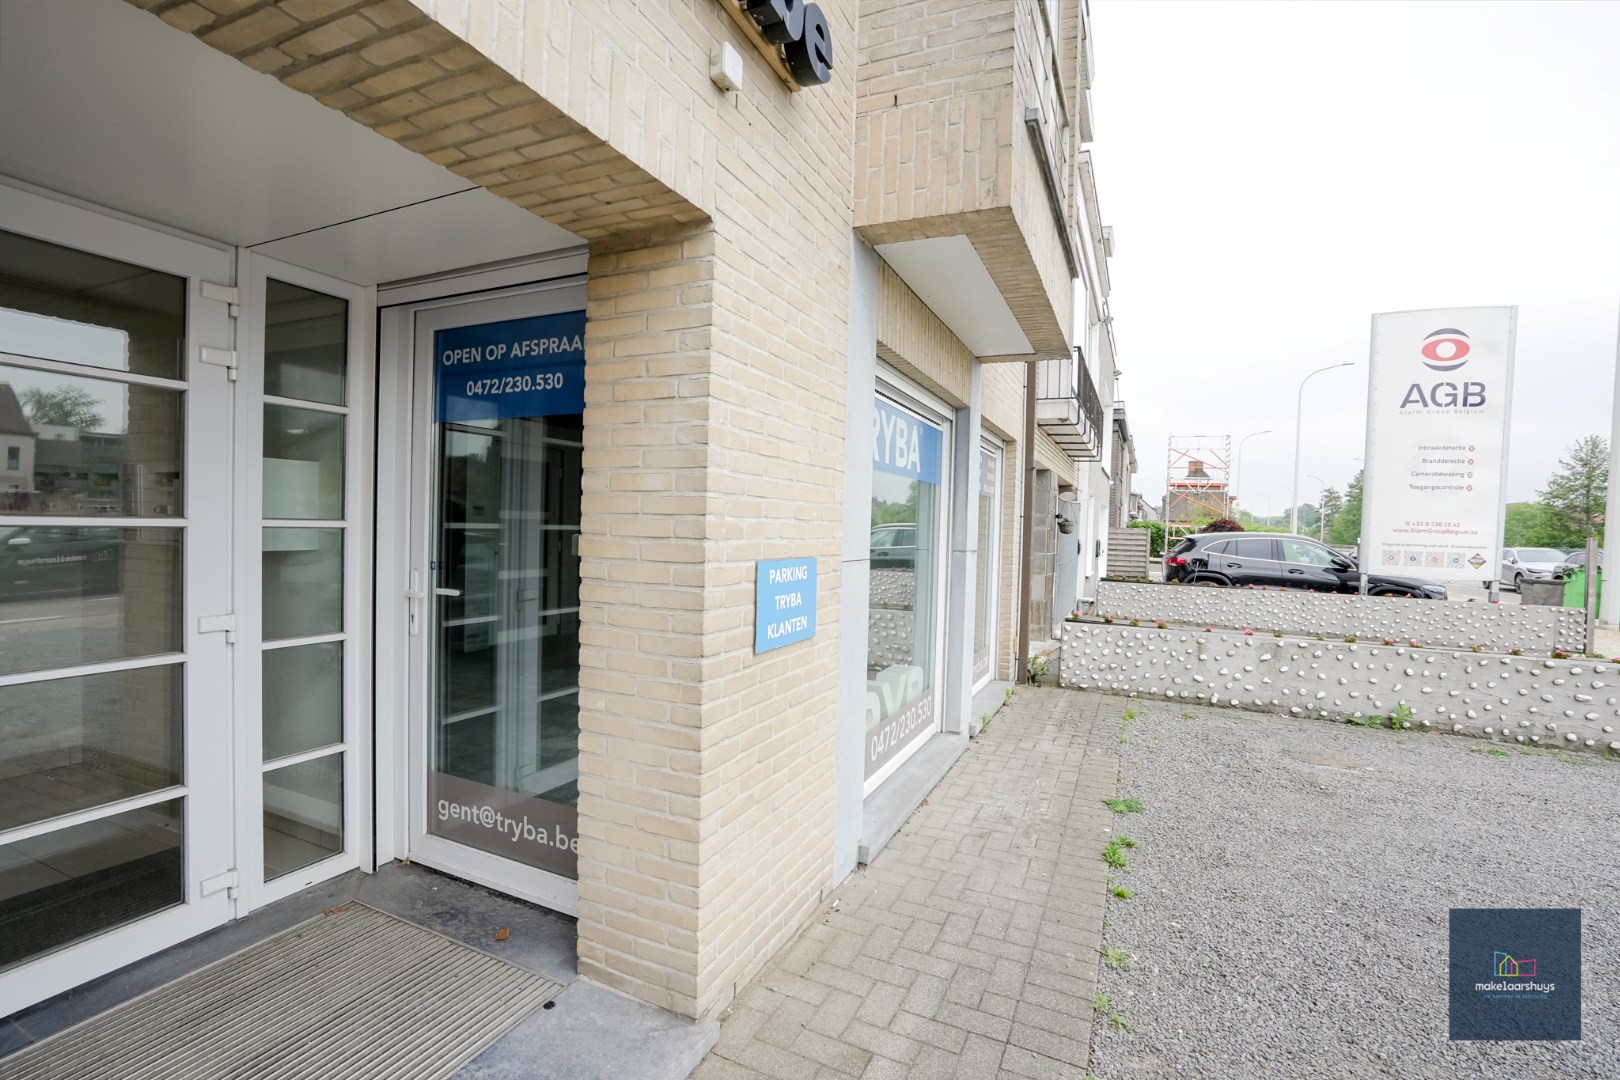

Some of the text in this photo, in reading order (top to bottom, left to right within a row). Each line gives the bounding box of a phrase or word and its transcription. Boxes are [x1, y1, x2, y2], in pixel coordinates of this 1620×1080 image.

[443, 334, 585, 366] OPEN OP AFSPRAA
[466, 372, 564, 396] 0472/230.530
[1399, 381, 1486, 409] AGB
[769, 565, 808, 585] PARKING
[775, 592, 802, 611] TRYBA
[767, 615, 808, 640] KLANTEN
[870, 695, 932, 761] 0472/230.530
[438, 799, 578, 854] gent@tryba.be
